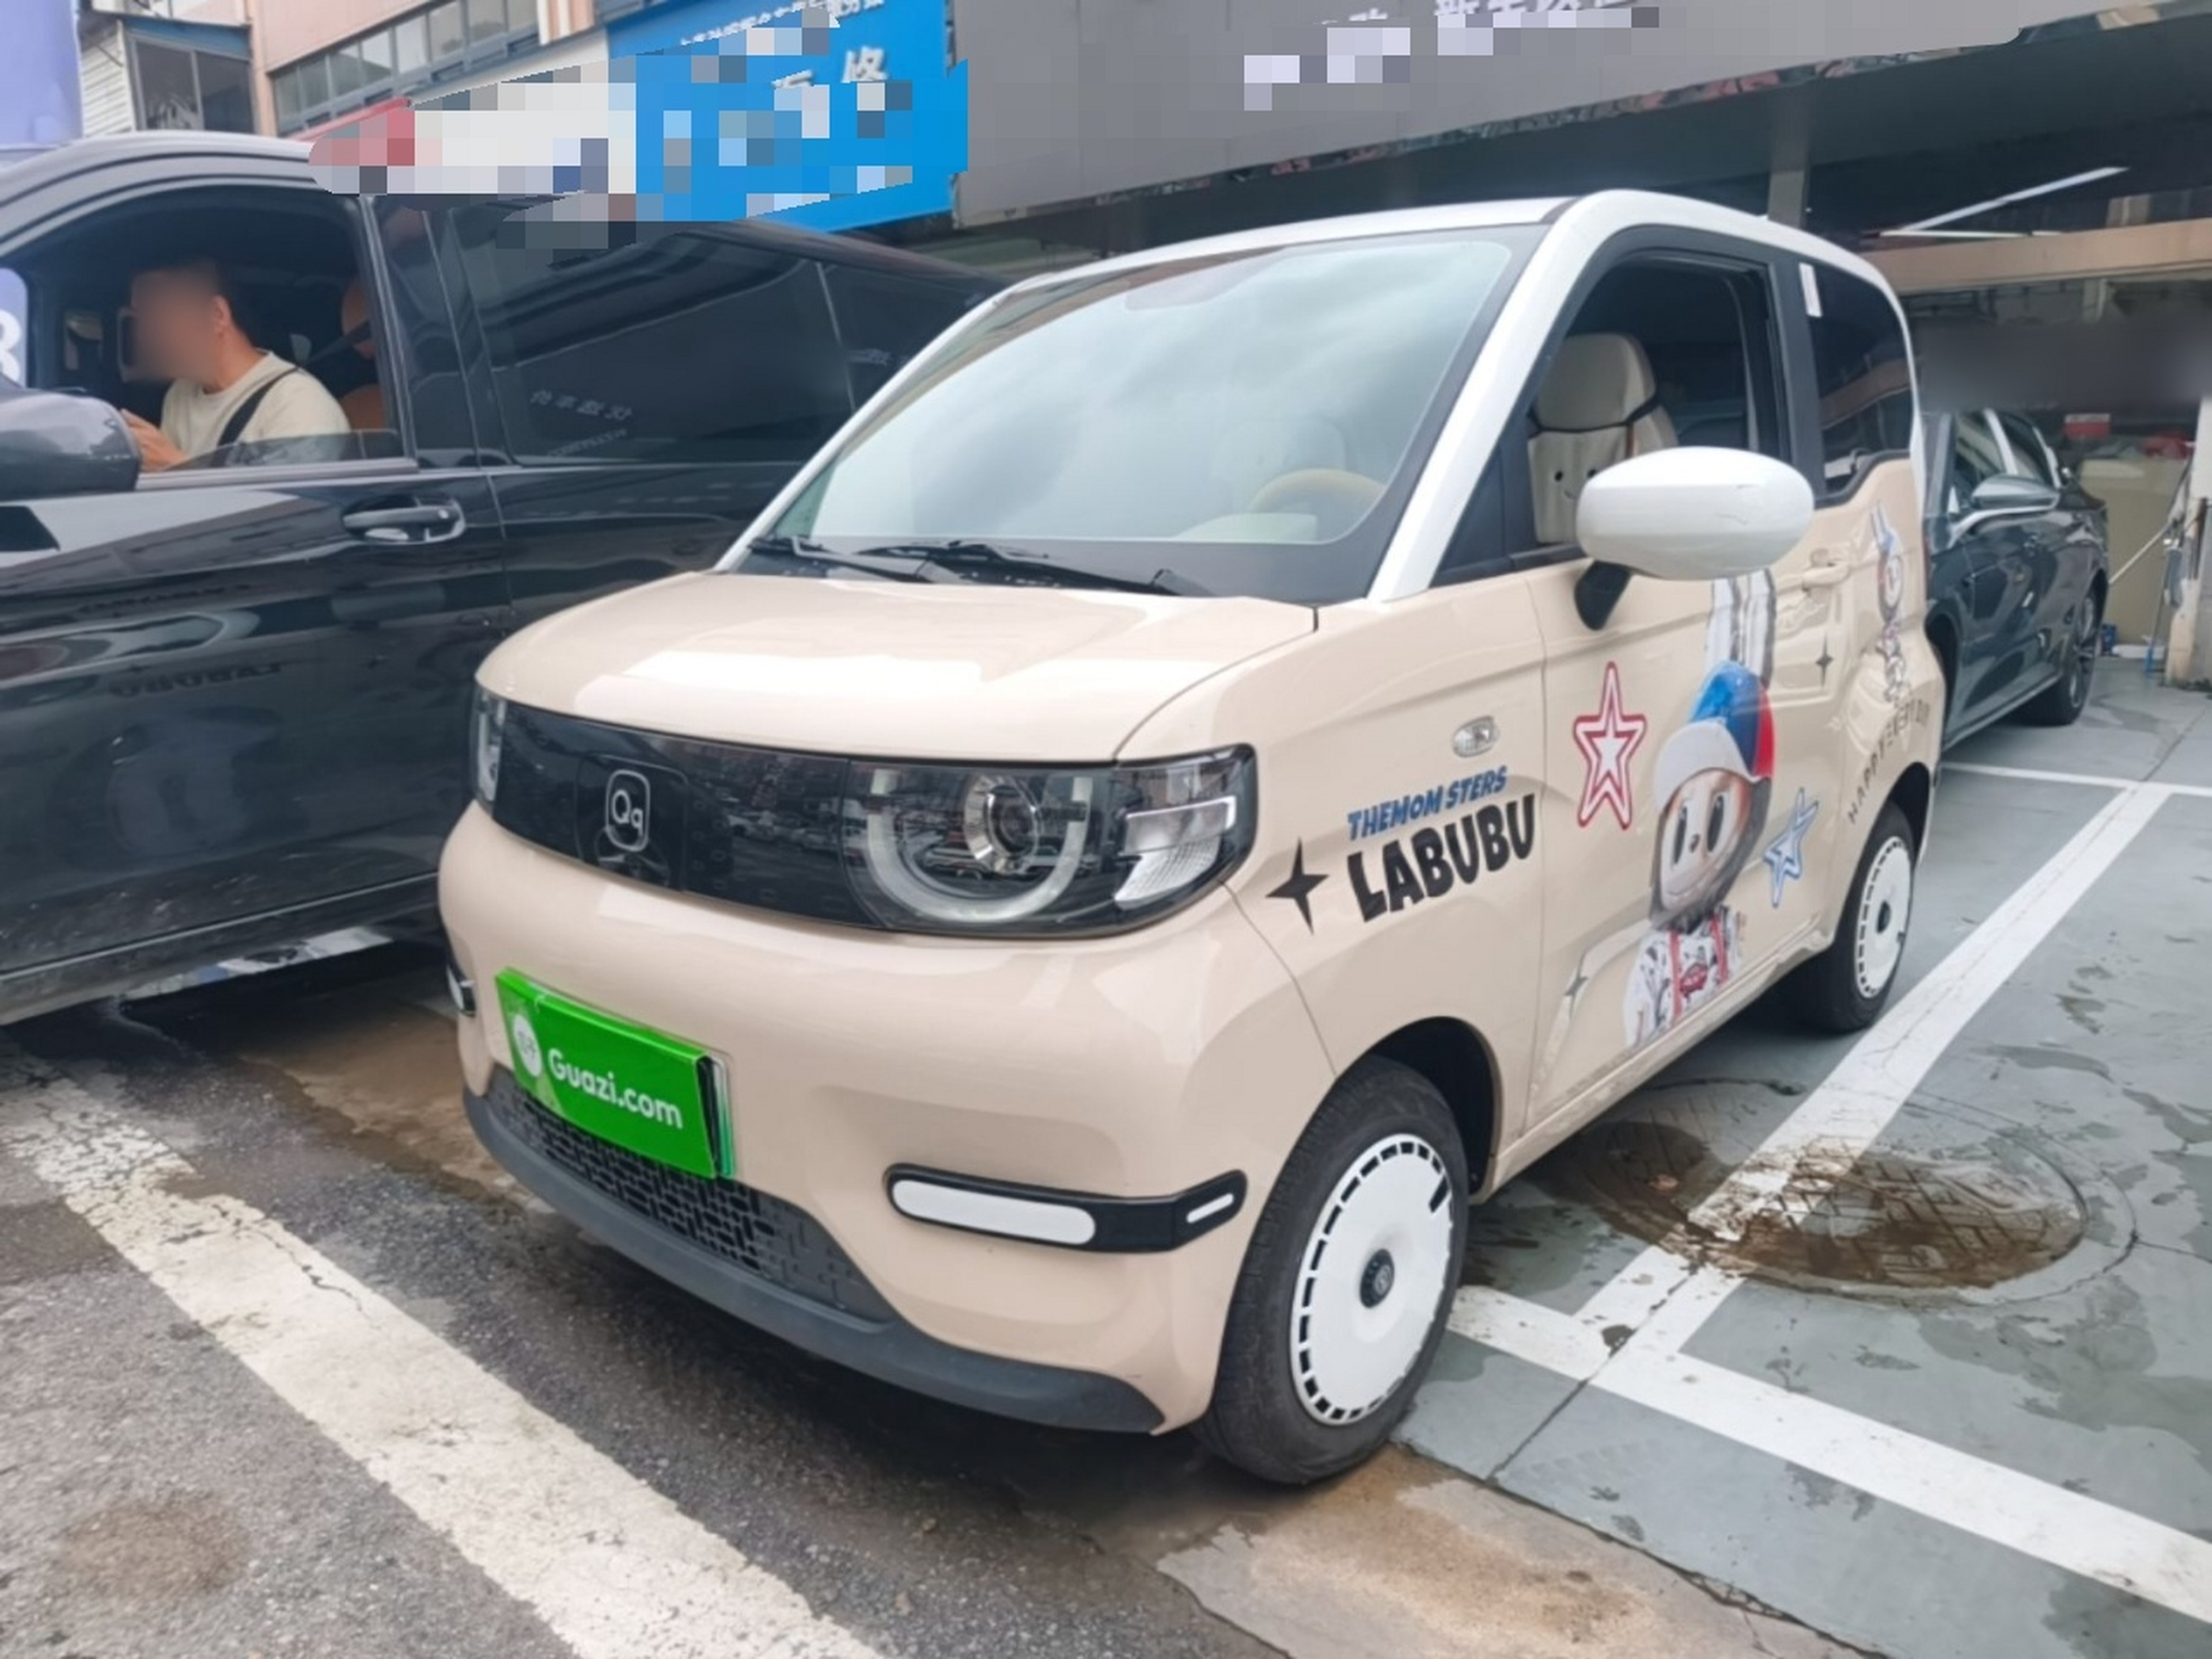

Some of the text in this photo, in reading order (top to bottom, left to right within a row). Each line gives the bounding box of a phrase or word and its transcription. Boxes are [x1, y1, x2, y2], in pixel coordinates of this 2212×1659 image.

[1446, 766, 1508, 810] STERS
[1347, 793, 1535, 923] LABUBU
[547, 1048, 683, 1130] Guazi.com
